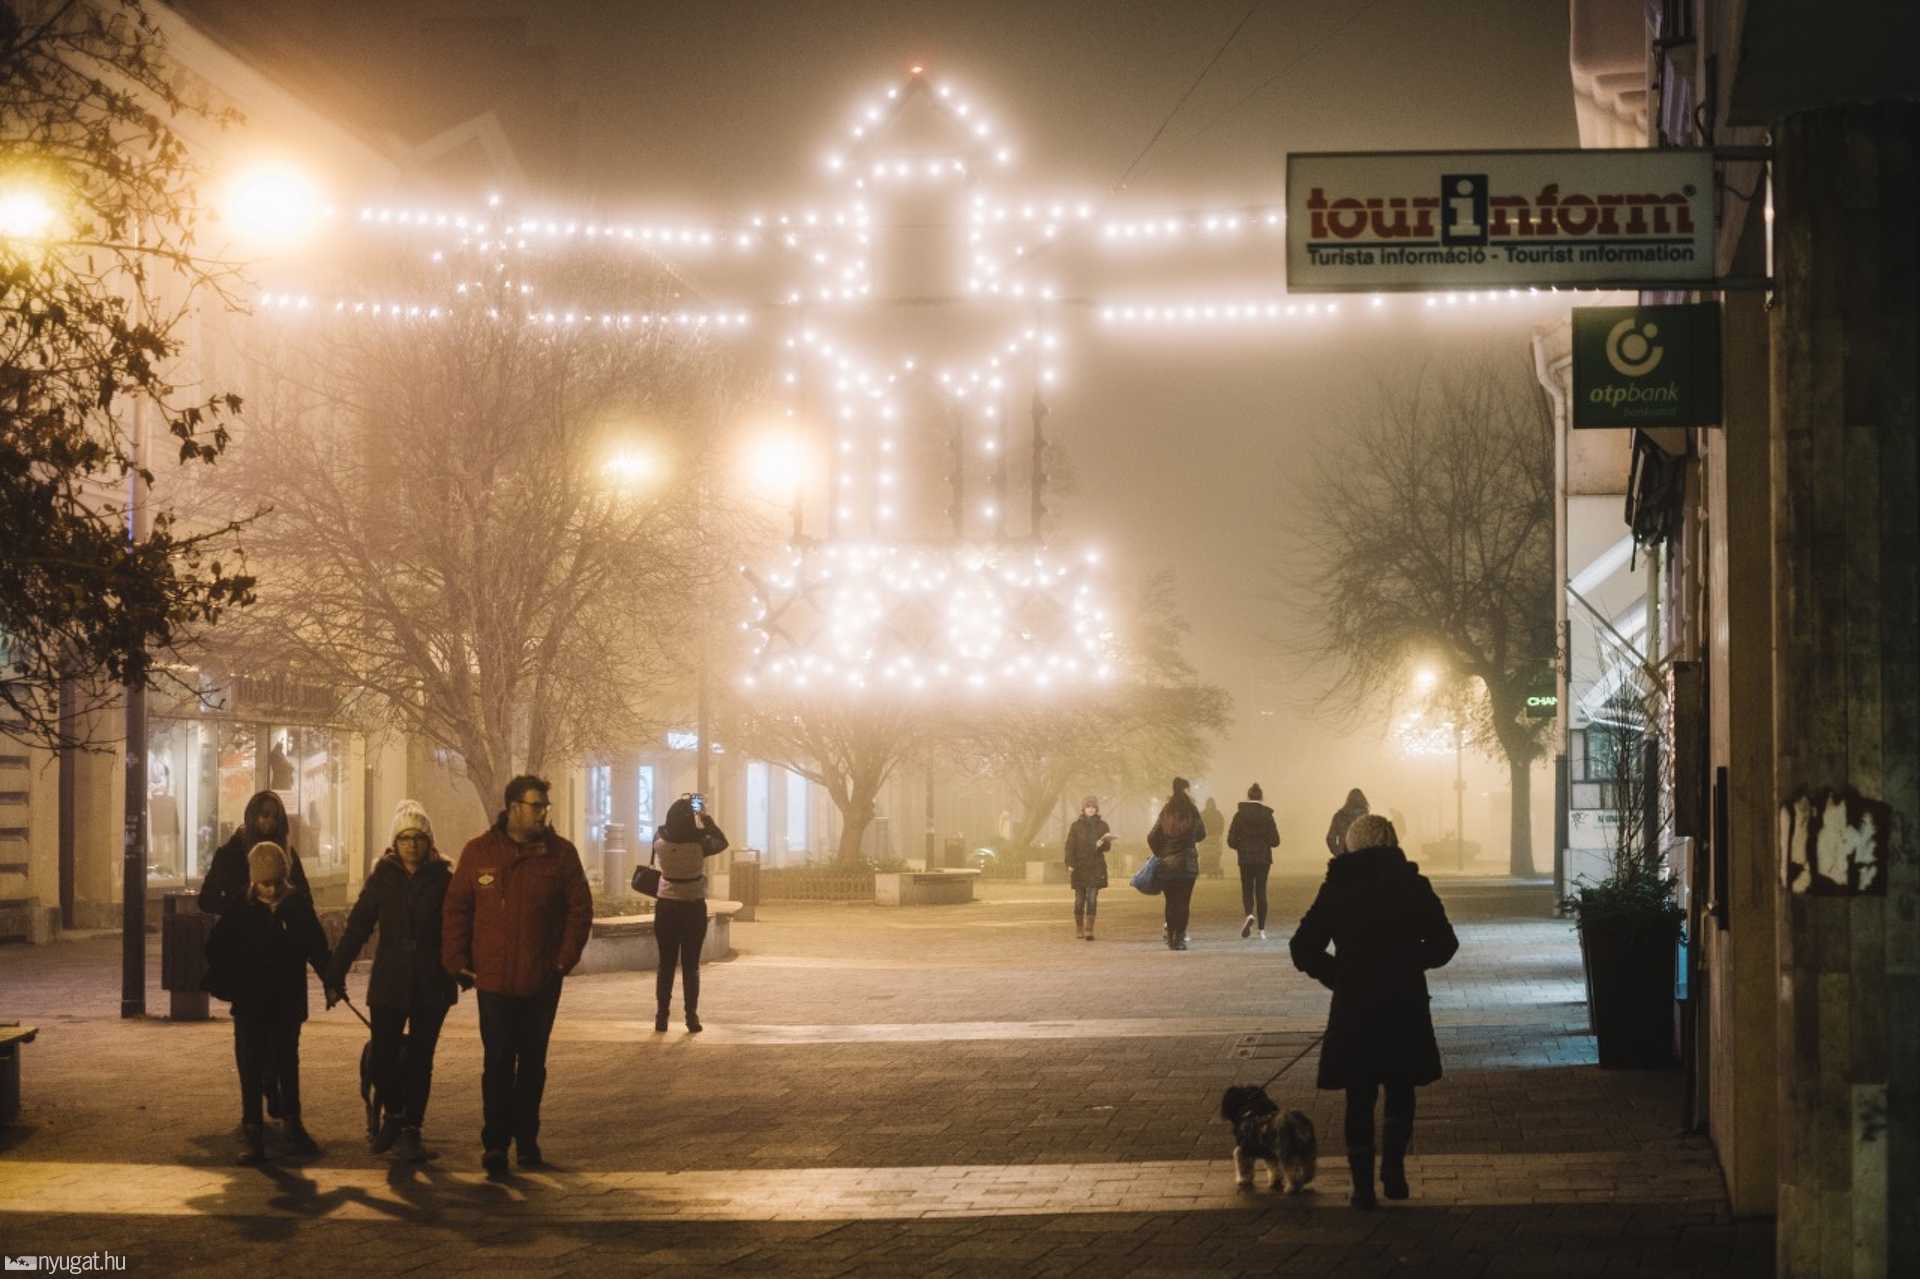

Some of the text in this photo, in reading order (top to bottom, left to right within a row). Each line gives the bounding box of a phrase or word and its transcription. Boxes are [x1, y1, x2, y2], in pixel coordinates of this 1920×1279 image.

[1308, 247, 1374, 265] Turista
[1380, 247, 1486, 265] információ
[1504, 246, 1574, 264] Tourist
[1579, 245, 1695, 263] information
[1589, 381, 1679, 408] otpbank
